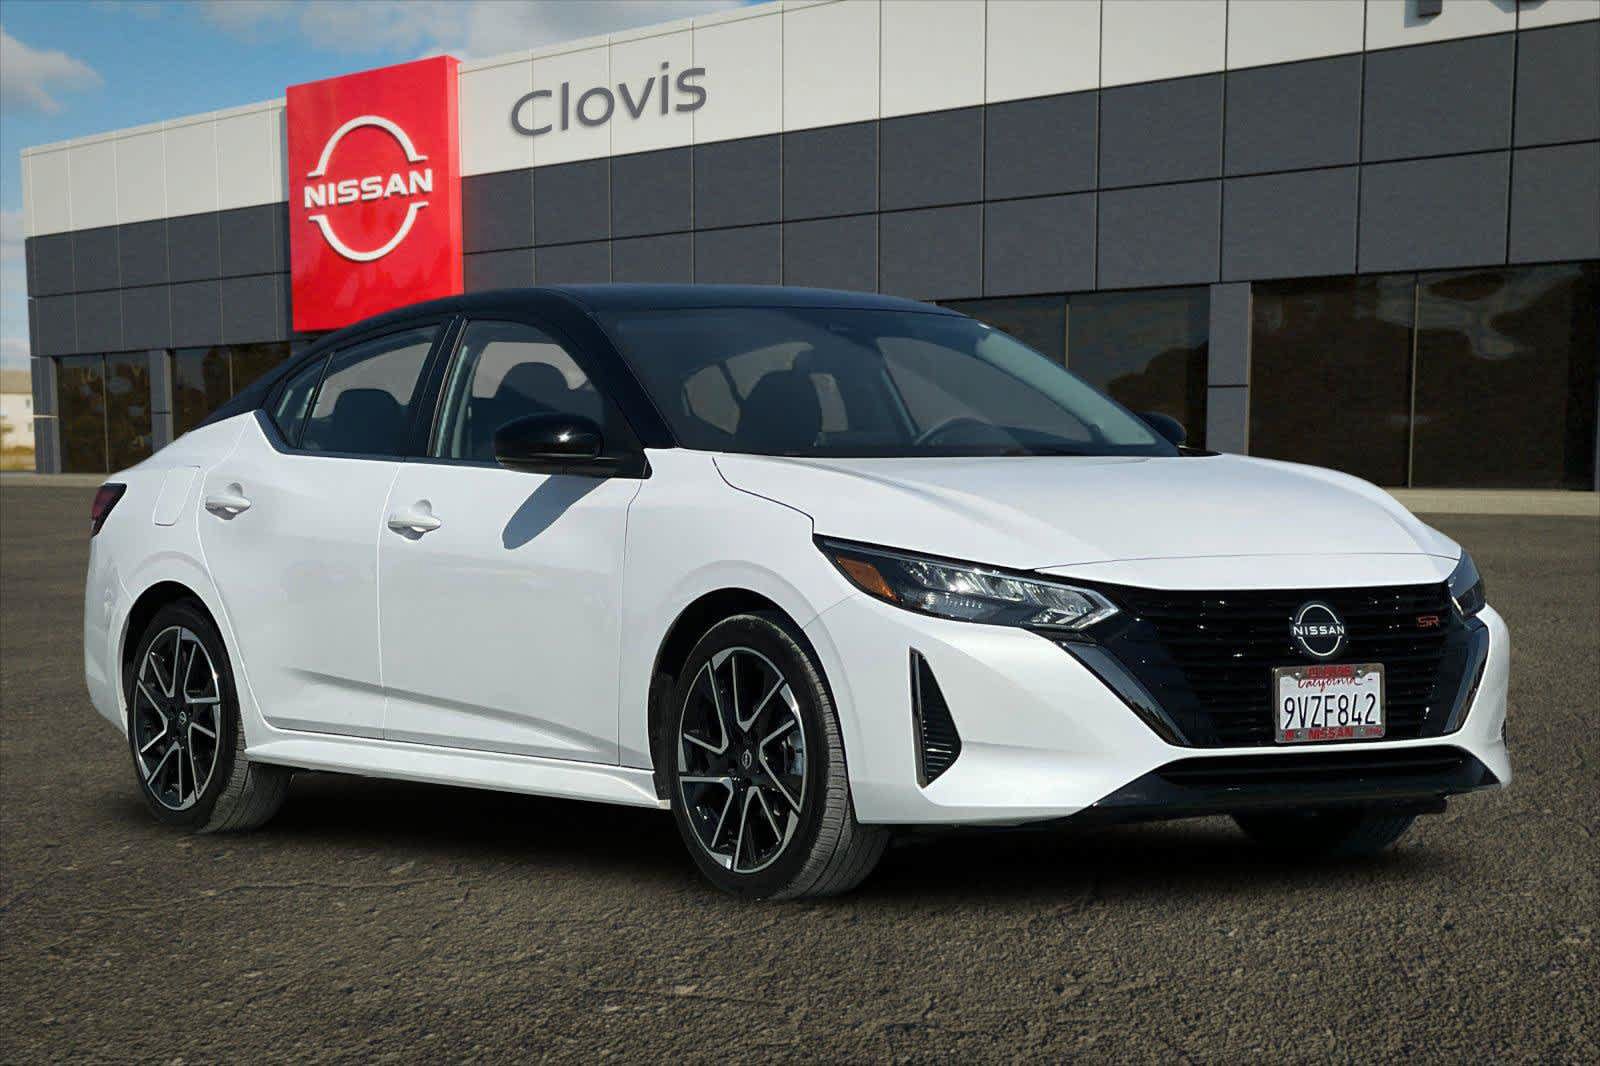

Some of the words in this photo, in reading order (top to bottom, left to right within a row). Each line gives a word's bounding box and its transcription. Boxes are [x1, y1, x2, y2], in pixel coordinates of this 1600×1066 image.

[511, 62, 707, 136] Clovis
[304, 168, 433, 208] NISSAN
[1293, 625, 1345, 636] NISSAN
[1417, 615, 1440, 628] SR
[1284, 693, 1376, 729] 9VZF842
